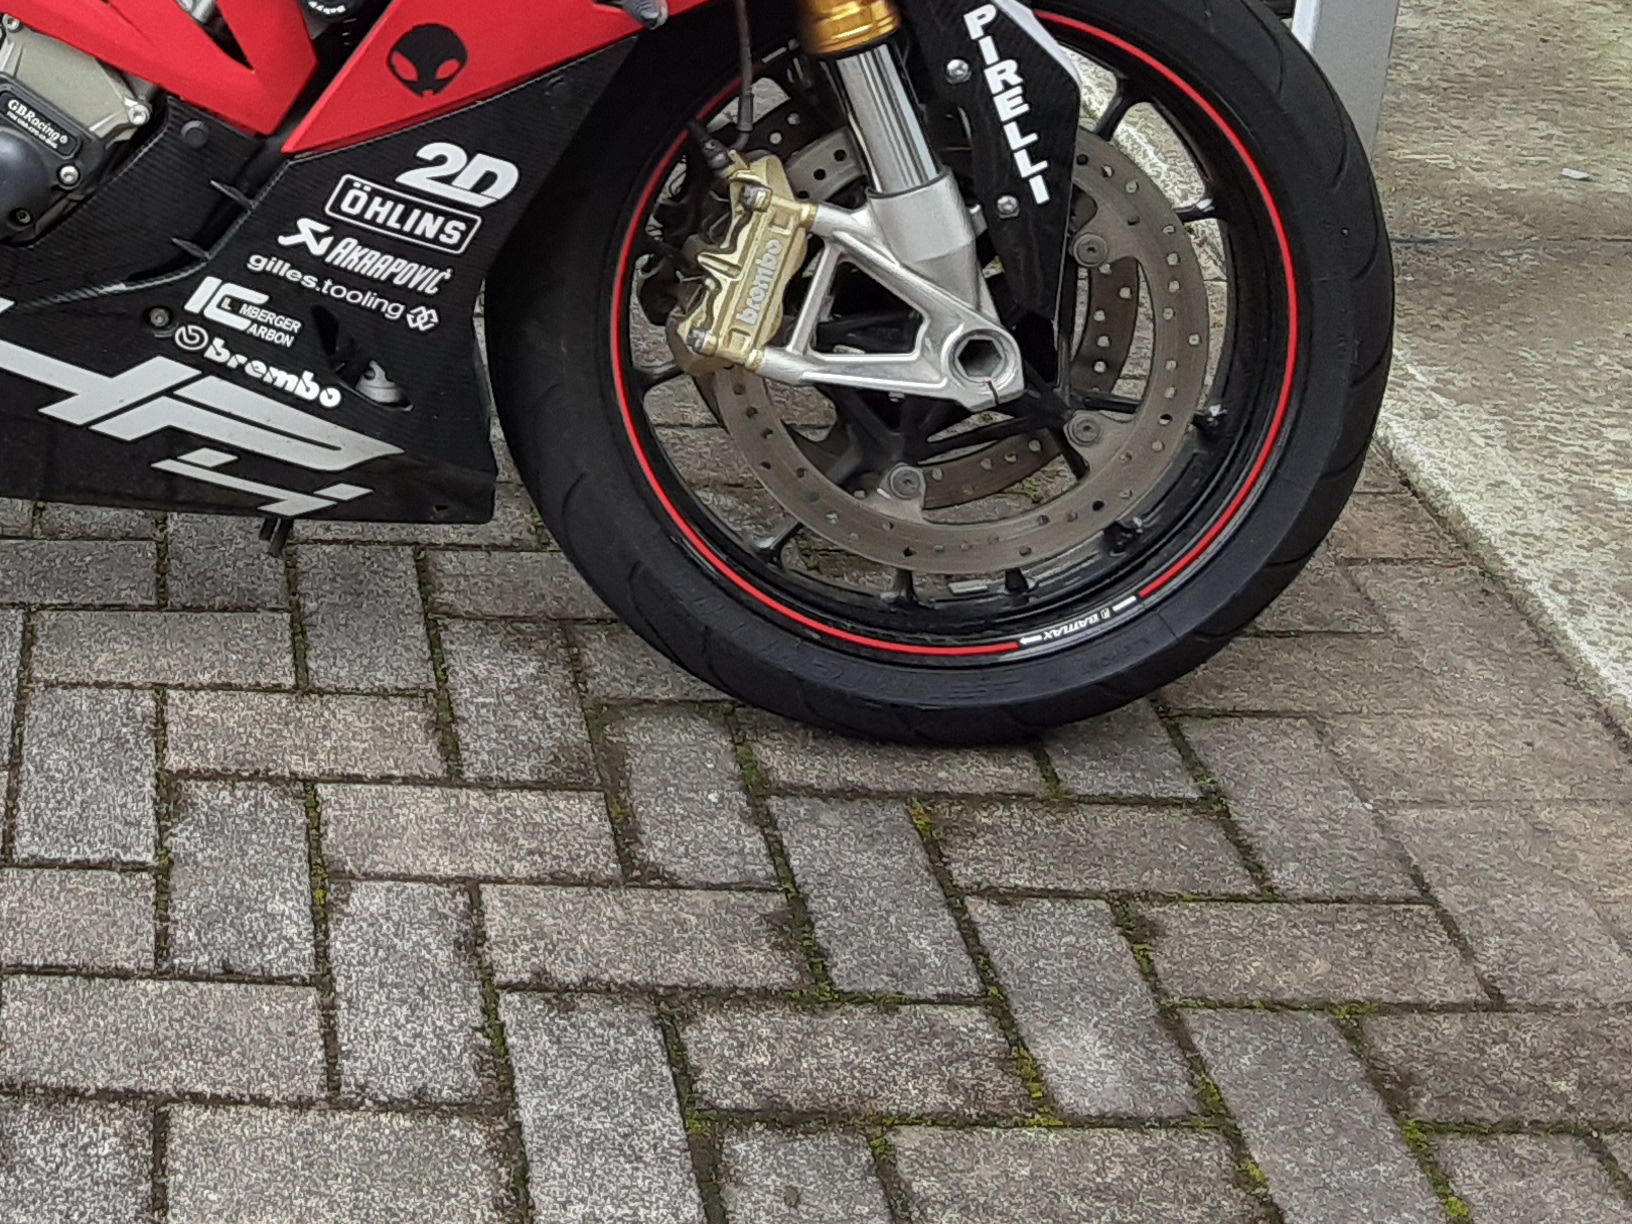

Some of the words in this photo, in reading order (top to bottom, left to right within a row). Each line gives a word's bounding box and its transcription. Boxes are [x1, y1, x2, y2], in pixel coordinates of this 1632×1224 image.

[963, 4, 1050, 205] PIRELLI
[395, 142, 519, 208] 2D
[339, 180, 467, 245] ÖHLINS
[735, 239, 783, 326] brembo
[203, 336, 342, 409] brembo
